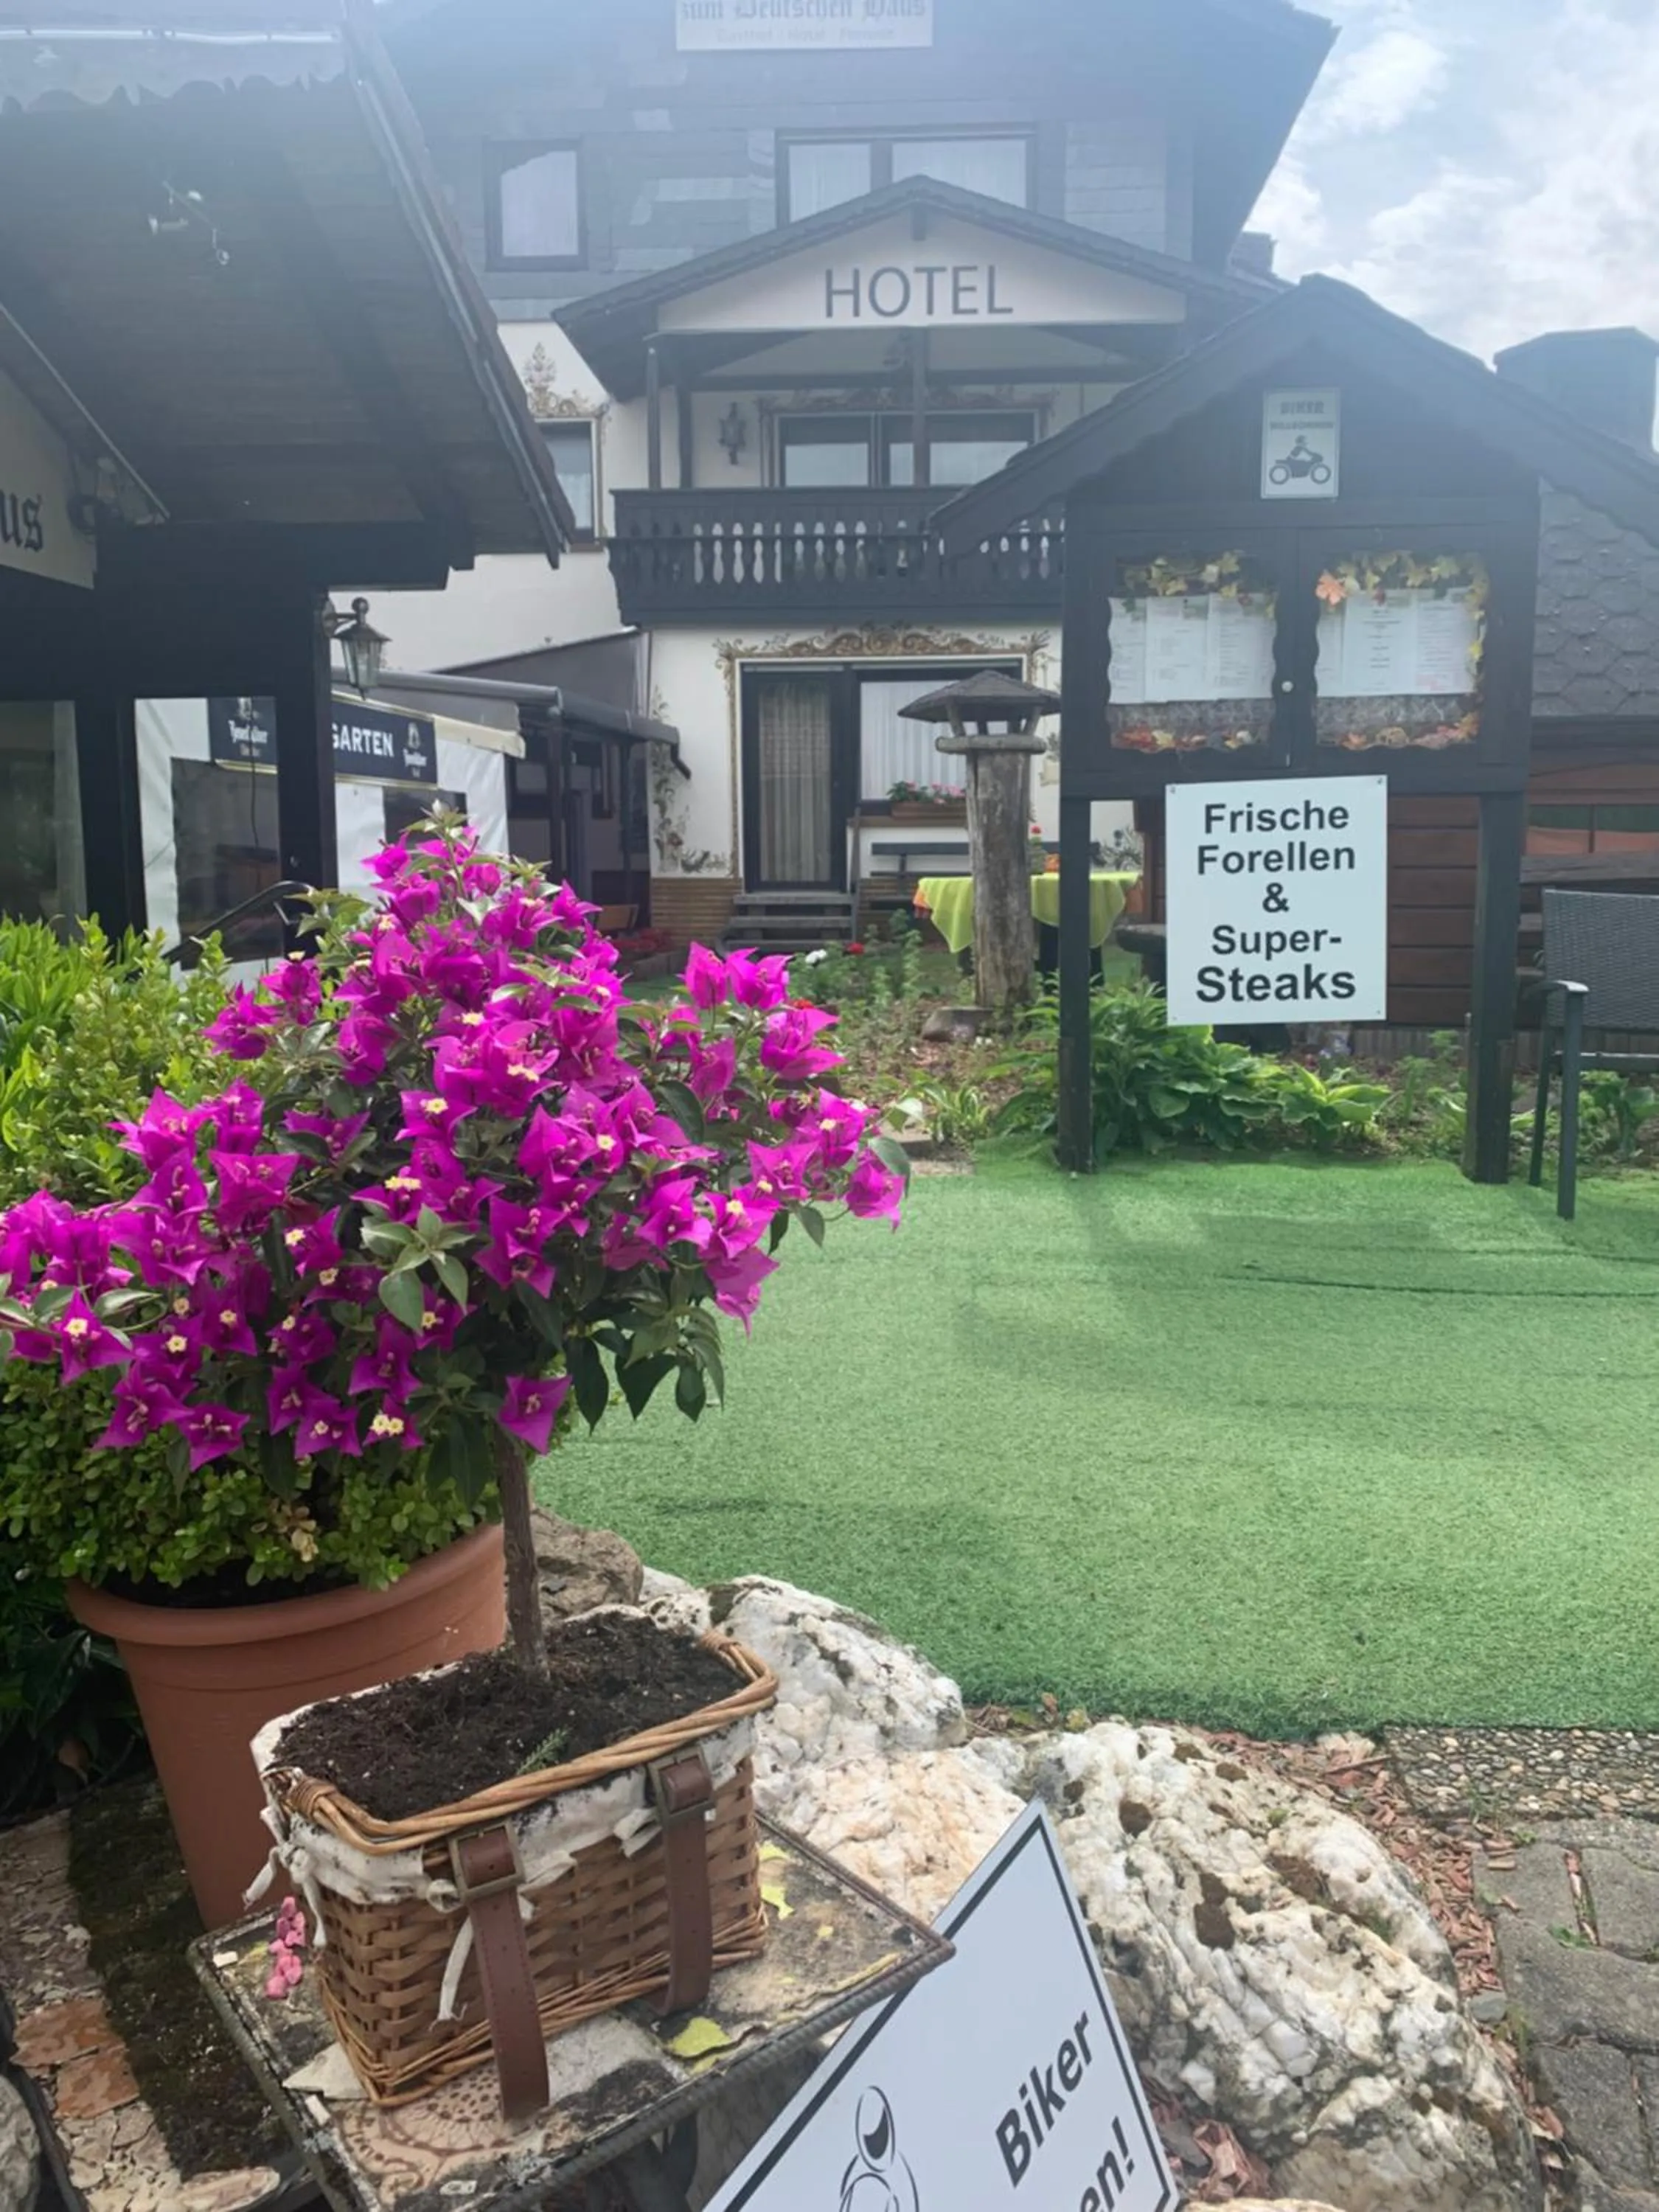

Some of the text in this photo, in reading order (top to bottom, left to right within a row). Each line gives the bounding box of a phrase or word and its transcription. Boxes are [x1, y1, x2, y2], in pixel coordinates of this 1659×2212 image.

[825, 265, 1014, 319] HOTEL
[1204, 800, 1349, 834] Frische
[1197, 841, 1355, 875] Forellen
[1262, 883, 1290, 913] &
[1211, 925, 1342, 961] Super-
[1196, 964, 1356, 1003] Steaks
[995, 2011, 1092, 2188] Biker
